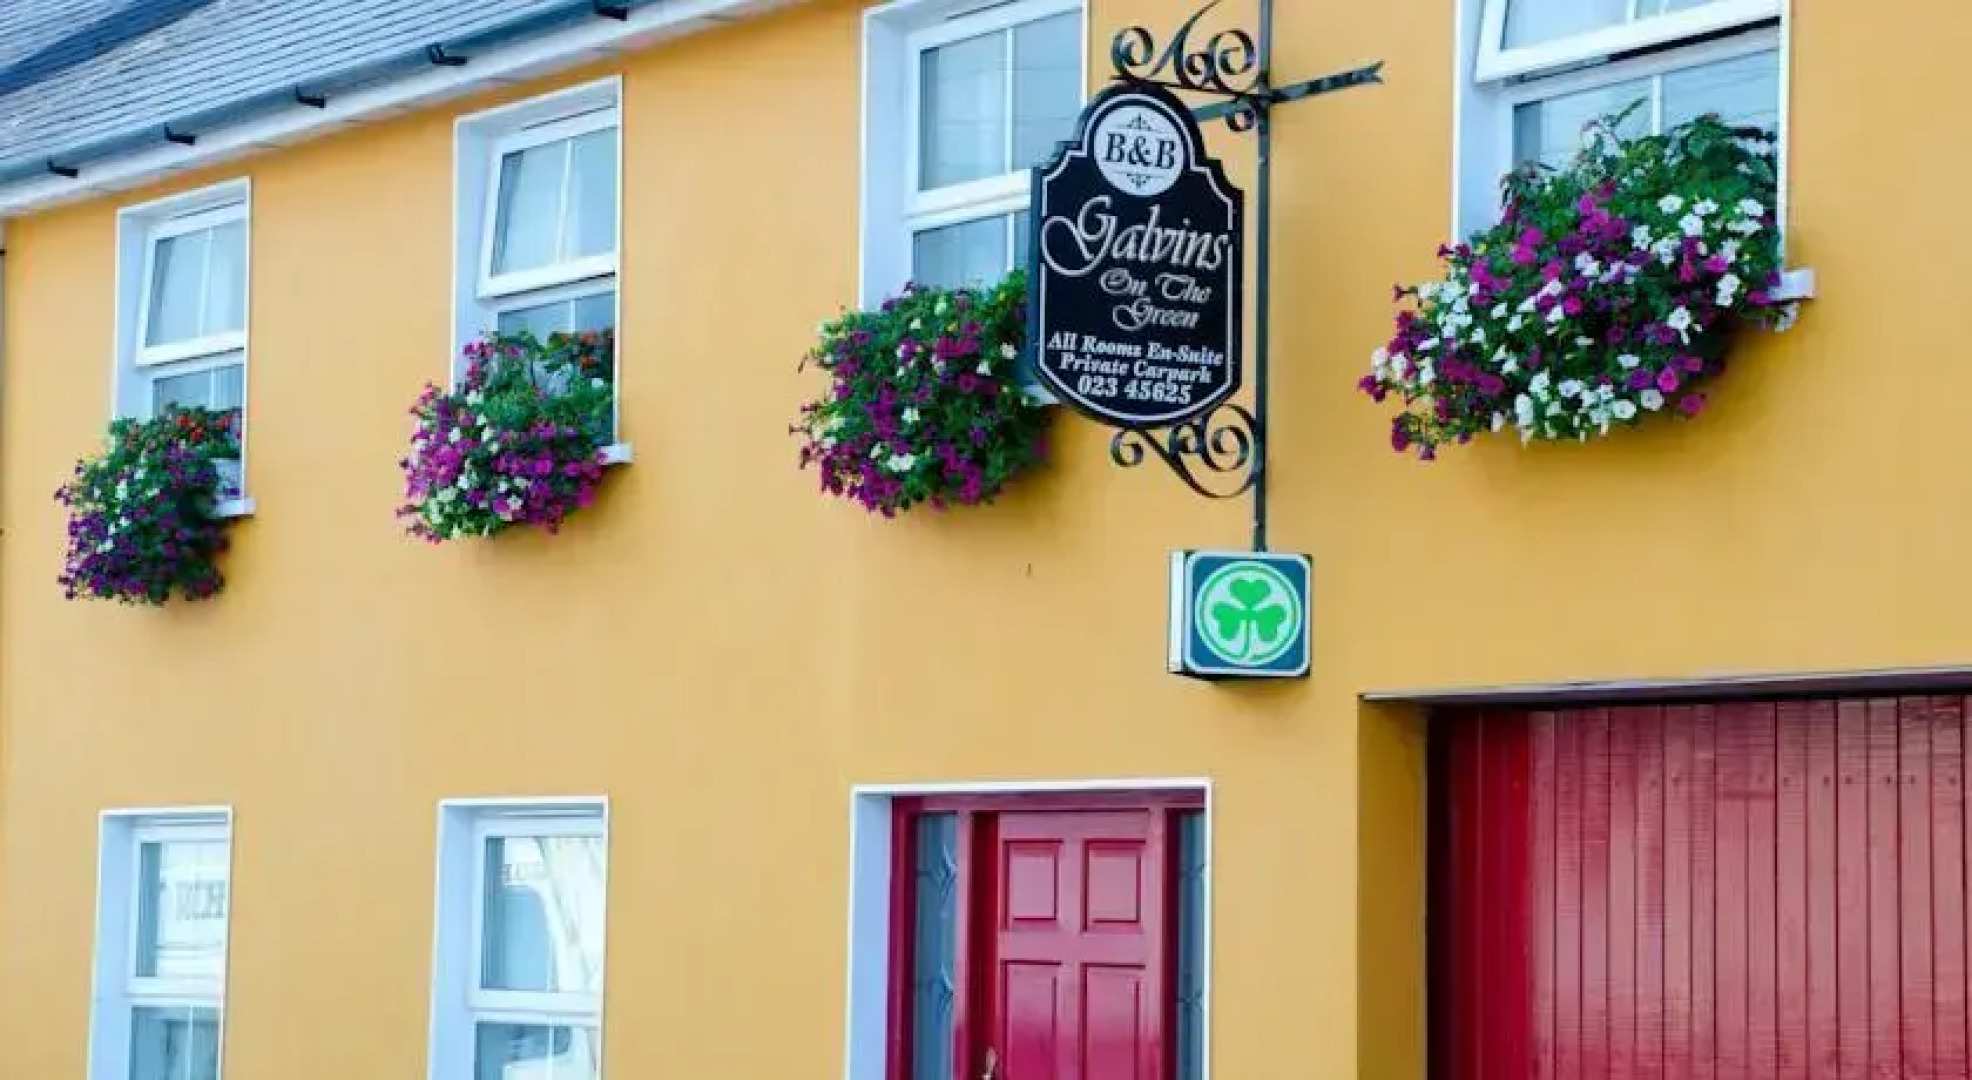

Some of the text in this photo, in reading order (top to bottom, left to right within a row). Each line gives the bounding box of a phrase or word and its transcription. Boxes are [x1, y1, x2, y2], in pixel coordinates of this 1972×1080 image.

[1105, 133, 1175, 170] B&B
[1040, 194, 1229, 277] Galvins
[1099, 267, 1212, 303] On The
[1112, 296, 1200, 331] Green
[1047, 331, 1224, 366] All Rooms En-Suite
[1059, 351, 1212, 383] Private Carpark
[1077, 374, 1193, 405] 023 45625
